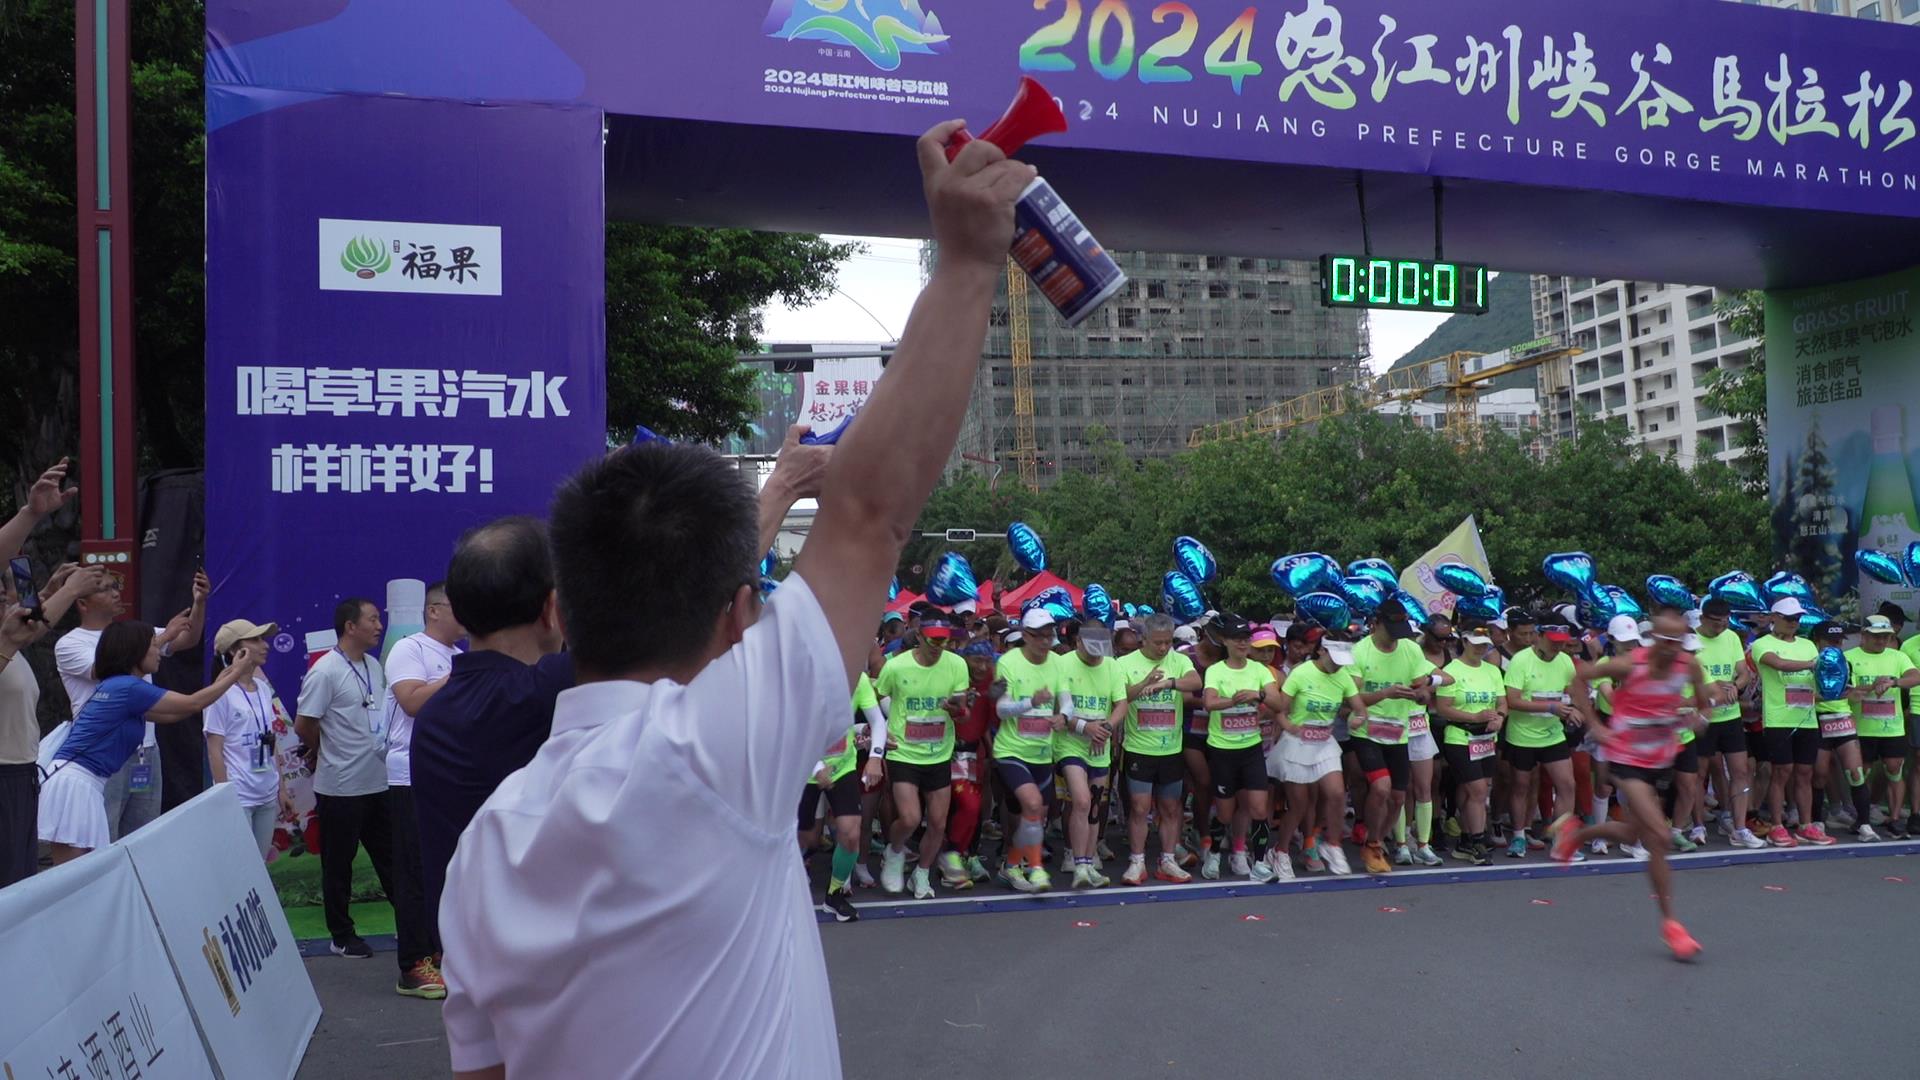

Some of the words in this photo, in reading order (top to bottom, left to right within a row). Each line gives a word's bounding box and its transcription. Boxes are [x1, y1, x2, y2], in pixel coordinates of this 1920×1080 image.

[764, 84, 792, 94] 2024
[793, 87, 827, 98] Nujiang
[828, 90, 878, 101] Prefecture
[878, 93, 906, 103] Gorge
[906, 95, 949, 106] Marathon
[1153, 105, 1326, 138] NUJIANG
[1358, 123, 1588, 160] PREFECTURE
[1615, 146, 1722, 172] GORGE
[1747, 158, 1916, 190] MARATHON
[401, 242, 481, 284] 福果
[1332, 257, 1483, 307] 0:00:01
[1793, 304, 1850, 333] GRASS
[1855, 290, 1909, 320] FRUIT
[1511, 336, 1552, 354] ZOOMLION
[1795, 315, 1913, 358] 天然草果气泡水
[815, 380, 877, 396] 金果银
[1796, 355, 1862, 385] 消食顺气
[236, 366, 570, 418] 喝草果汽水
[1796, 378, 1862, 408] 旅途佳品
[1072, 694, 1107, 711] 配速员
